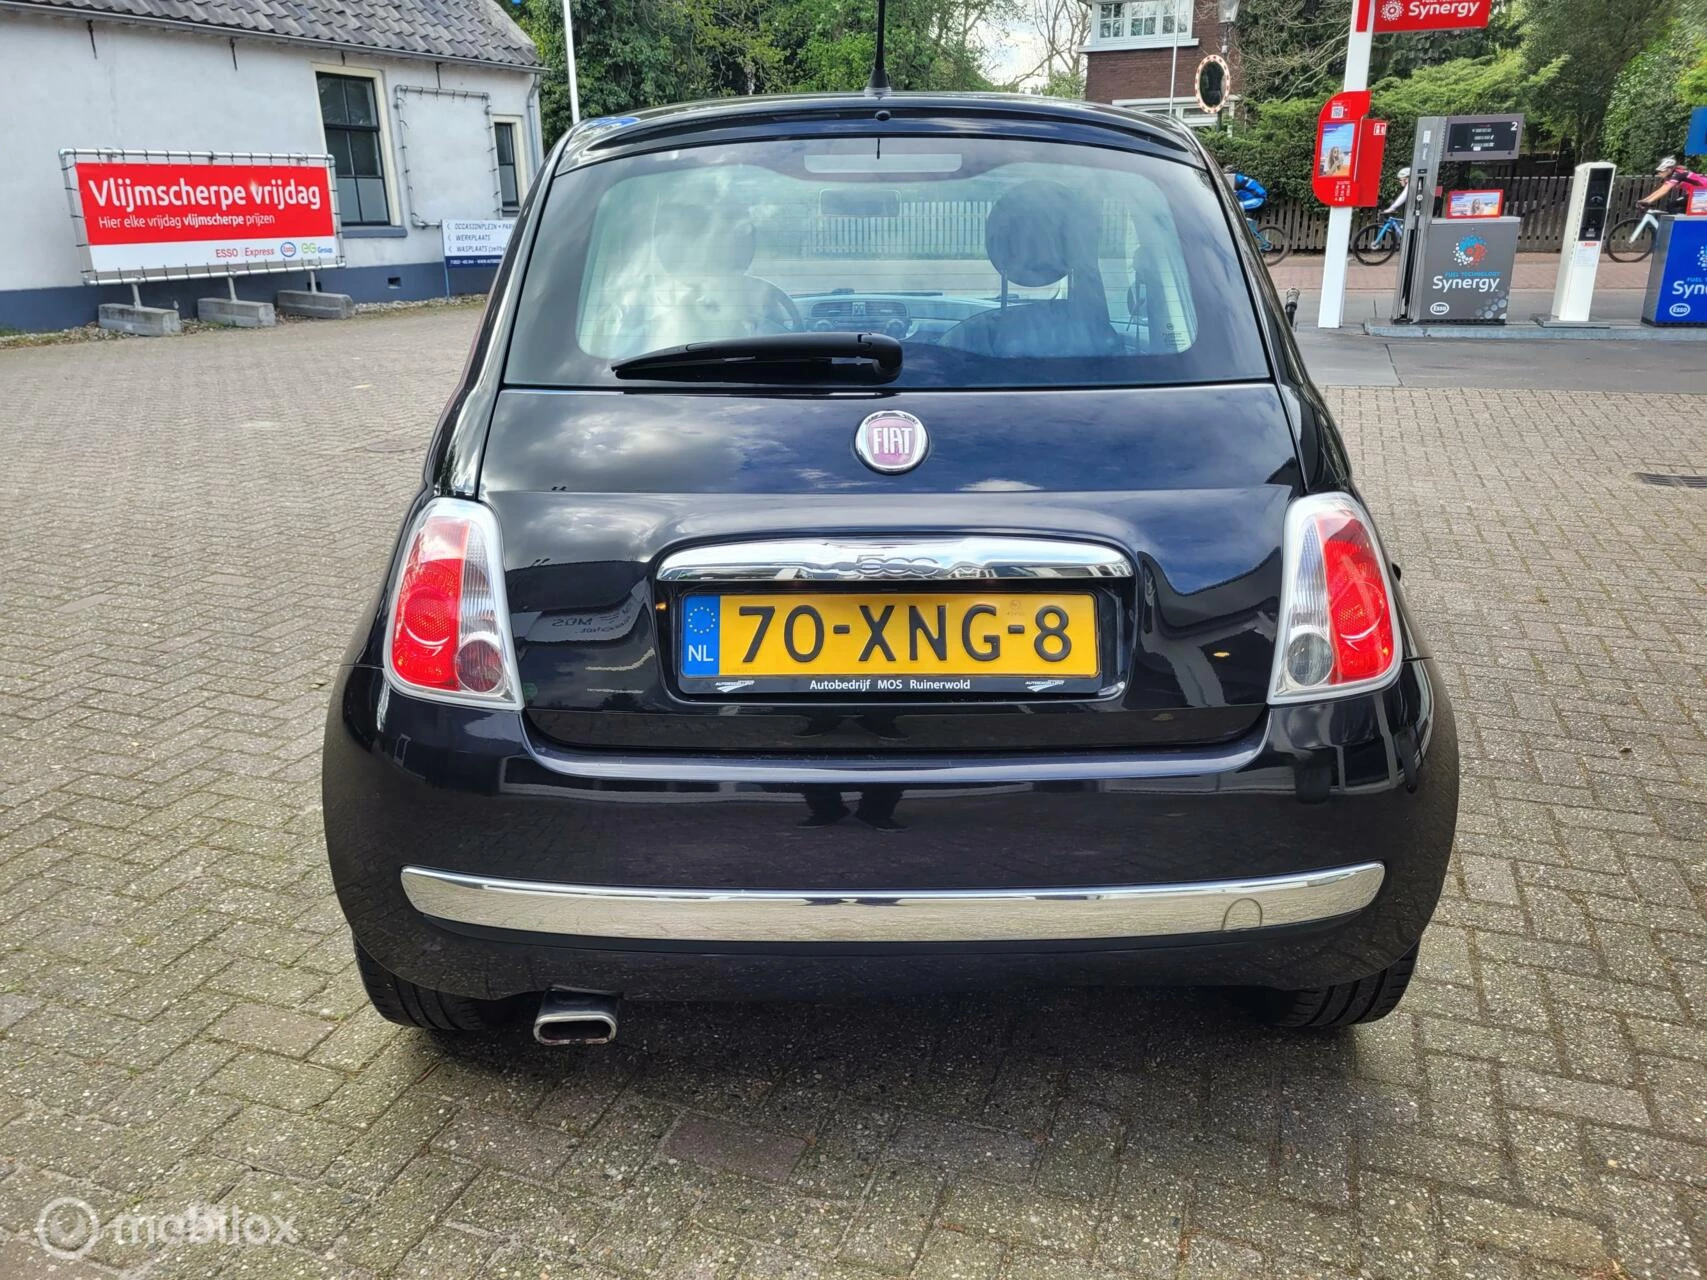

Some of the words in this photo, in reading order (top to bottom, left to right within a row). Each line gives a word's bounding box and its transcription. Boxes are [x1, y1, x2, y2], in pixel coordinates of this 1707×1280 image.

[1408, 1, 1480, 19] Synergy
[1510, 121, 1518, 131] 2
[88, 178, 246, 212] Vlijmscherpe
[250, 179, 320, 211] vrijdag
[98, 217, 121, 229] Hier
[124, 216, 146, 228] elke
[147, 215, 182, 229] vrijdag
[183, 213, 245, 227] vlijmscherpe
[246, 213, 276, 227] prijzen
[216, 248, 238, 258] ESSO
[245, 247, 275, 258] Express
[1432, 275, 1500, 293] Synergy
[1672, 280, 1707, 299] Syn
[873, 427, 912, 454] FIAT
[738, 604, 1073, 663] 70-XNG-8
[688, 644, 714, 662] NL
[810, 679, 871, 691] Autobedrijf
[877, 679, 902, 690] MOS
[910, 679, 971, 690] Ruinerwold
